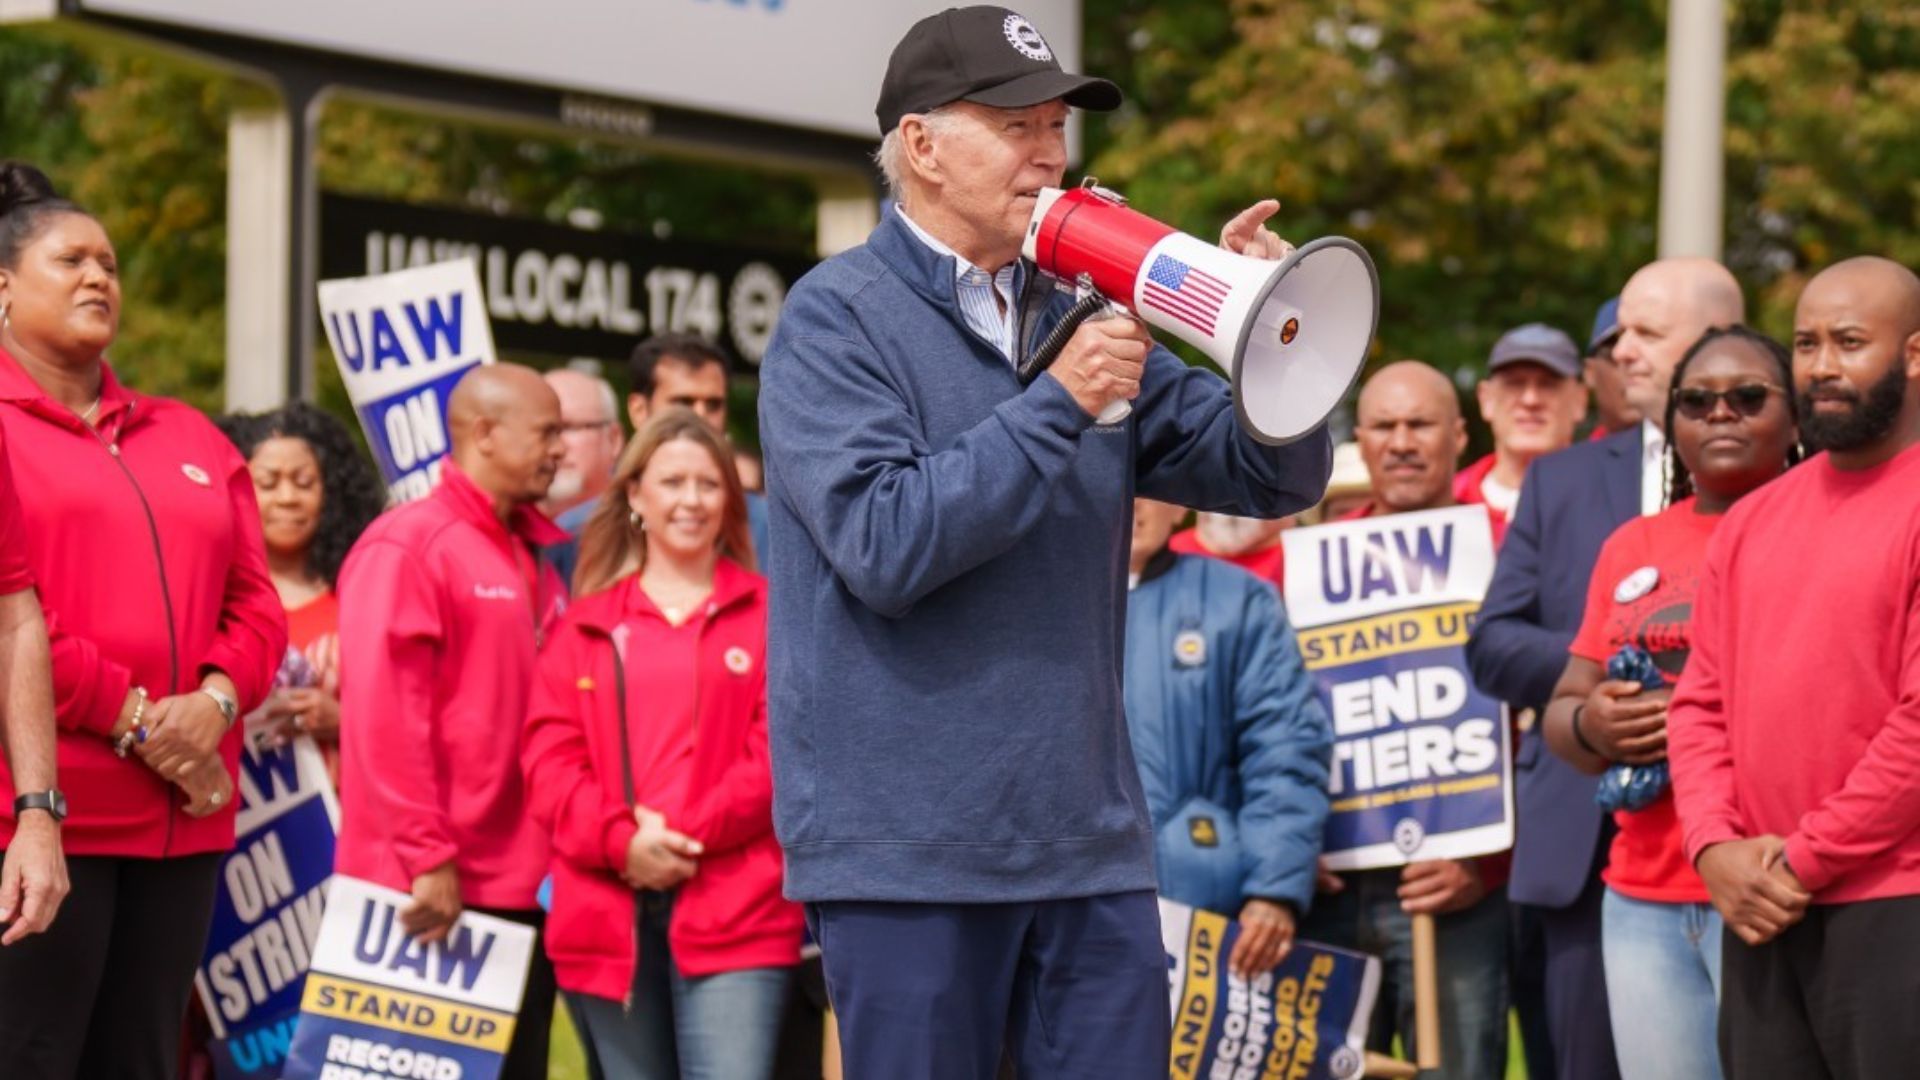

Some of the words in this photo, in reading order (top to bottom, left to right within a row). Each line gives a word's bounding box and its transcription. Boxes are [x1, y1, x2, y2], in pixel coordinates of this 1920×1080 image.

[331, 291, 464, 374] UAW
[486, 246, 644, 333] LOCAL
[645, 267, 721, 340] 174
[384, 388, 447, 470] ON
[1319, 521, 1455, 604] UAW
[1304, 619, 1421, 661] STAND
[1331, 665, 1467, 736] END
[1328, 717, 1498, 795] TIERS
[225, 830, 296, 925] ON
[354, 898, 497, 992] UAW
[316, 984, 436, 1027] STAND
[449, 1014, 497, 1041] UP
[1172, 992, 1207, 1075] AND
[1193, 928, 1212, 978] UP
[326, 1033, 463, 1080] RECORD
